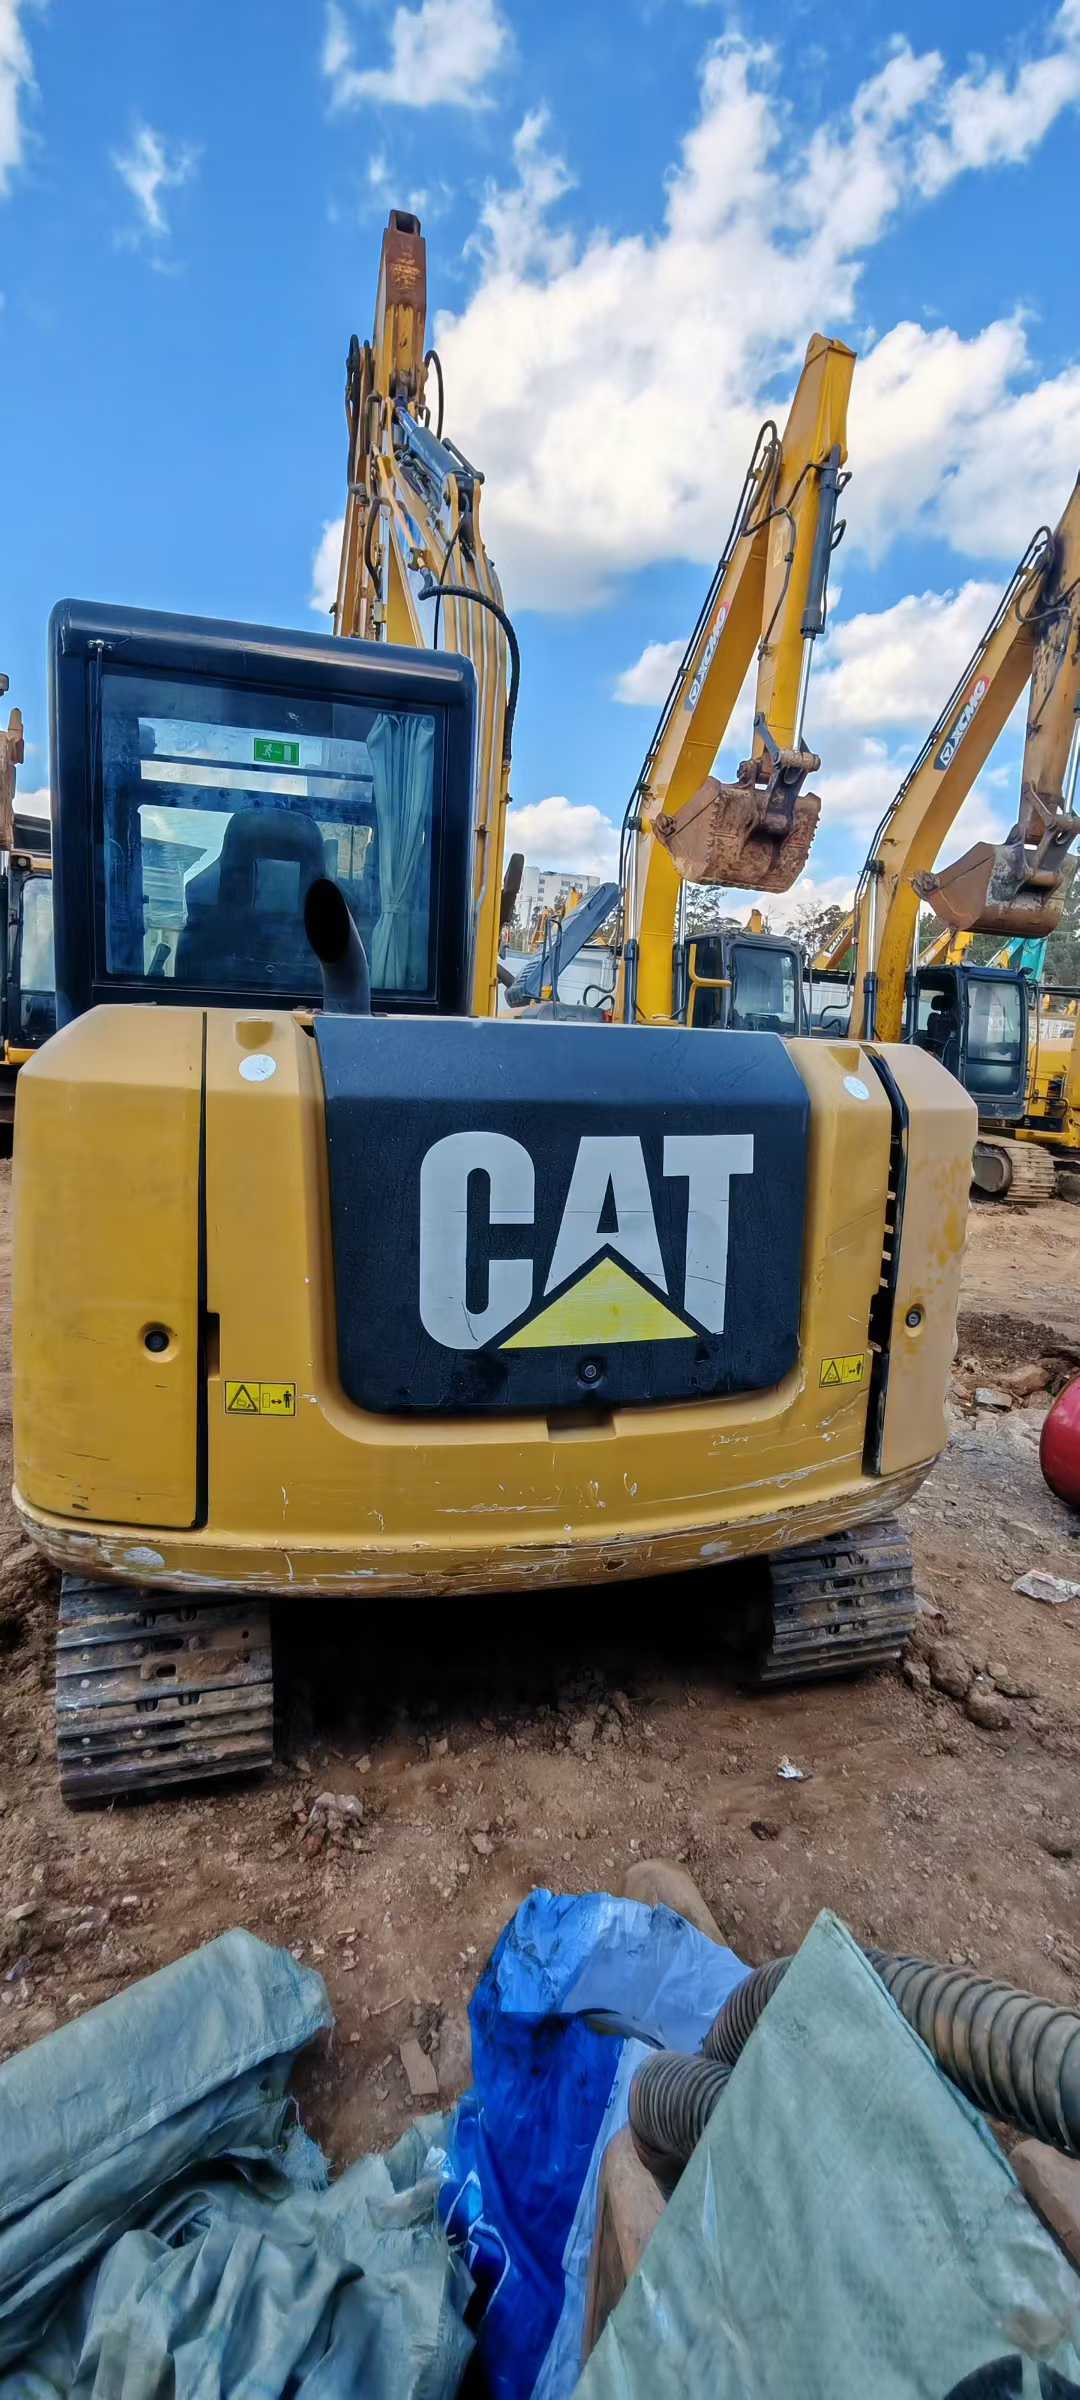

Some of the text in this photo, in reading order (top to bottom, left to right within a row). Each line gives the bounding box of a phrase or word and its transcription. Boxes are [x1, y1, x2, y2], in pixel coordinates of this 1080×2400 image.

[697, 607, 727, 682] XCMG
[950, 679, 987, 748] XCMG
[420, 1131, 754, 1349] CAT
